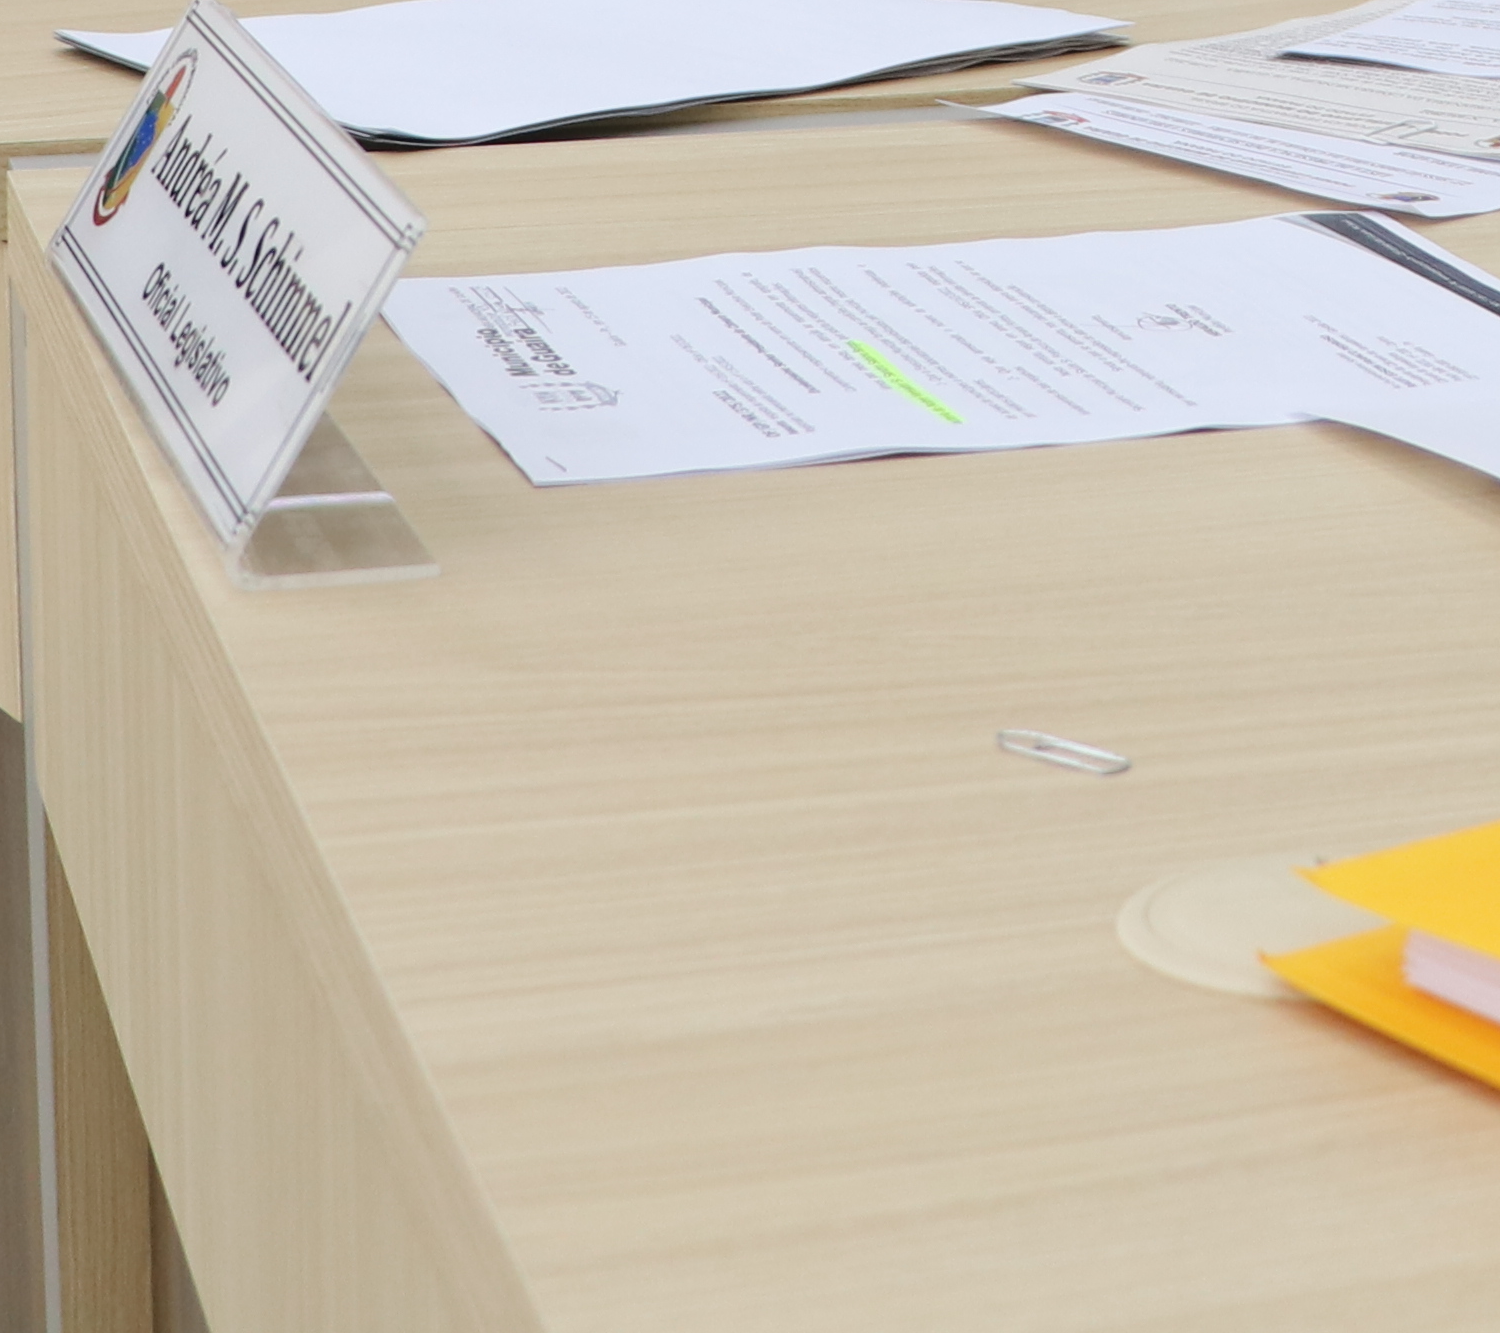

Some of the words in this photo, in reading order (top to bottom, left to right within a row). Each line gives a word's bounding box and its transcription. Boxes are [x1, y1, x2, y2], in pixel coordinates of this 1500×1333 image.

[151, 114, 228, 231] Andréa
[201, 172, 250, 256] M.
[220, 198, 266, 276] S.
[143, 262, 187, 331] Oficial
[170, 302, 230, 407] Legislativo
[235, 217, 353, 383] Schimmel
[542, 362, 577, 376] de
